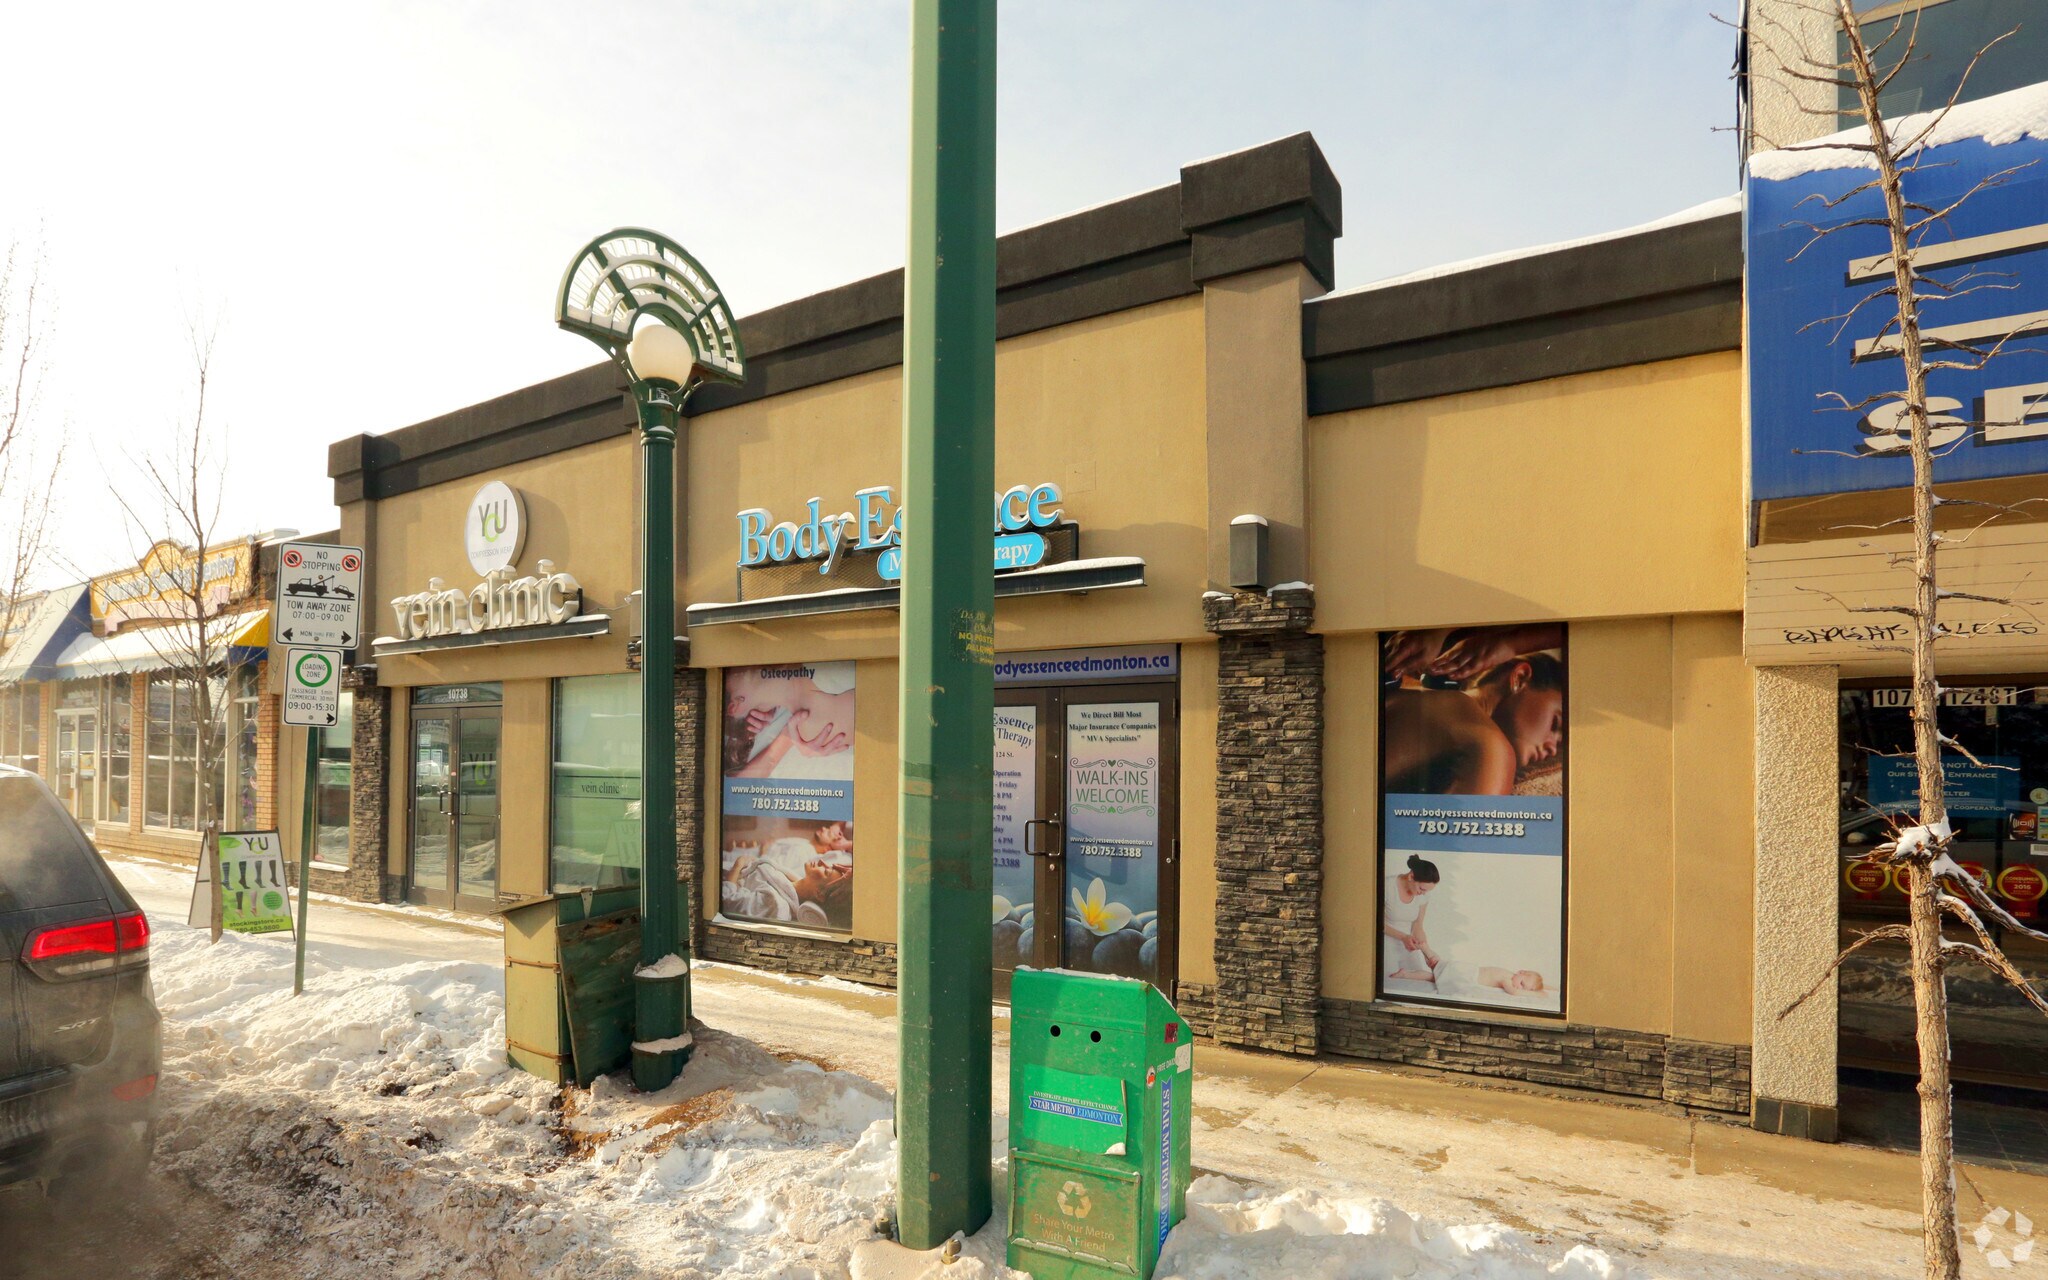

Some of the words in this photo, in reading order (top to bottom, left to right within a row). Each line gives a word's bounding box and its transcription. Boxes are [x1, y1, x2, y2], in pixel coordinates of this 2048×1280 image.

[736, 498, 850, 575] Body
[317, 551, 328, 559] NO
[994, 543, 1033, 567] rapy
[302, 561, 340, 571] STOPPING
[286, 600, 303, 609] TOW
[306, 602, 327, 610] AWAY
[329, 603, 351, 612] ZONE
[391, 580, 465, 639] vein
[467, 562, 578, 633] clinic
[760, 666, 815, 680] Osteopathy
[995, 655, 1169, 678] odyessenceedmonton.ca
[448, 688, 468, 699] 10738
[1121, 723, 1157, 731] Companies
[997, 728, 1032, 749] Therapy
[1077, 771, 1148, 785] WALK-INS
[581, 782, 597, 793] vein
[599, 783, 620, 794] clinic
[731, 785, 844, 798] www.bodyessenceedmonton.ca
[1076, 788, 1149, 803] WELCOME
[752, 797, 819, 812] 780.752.3388
[1394, 808, 1552, 820] www.bodyessenceedmonton.ca
[1419, 820, 1525, 837] 780.752.3388
[1080, 845, 1142, 857] 780.752.3388
[229, 919, 284, 927] stockingstore.ca
[54, 1017, 102, 1033] SRT
[1032, 1099, 1050, 1110] STAR
[1050, 1102, 1075, 1115] METRO
[1077, 1108, 1118, 1124] EDMONTON
[1162, 1089, 1170, 1128] STAR
[1161, 1132, 1170, 1189] METRO
[1034, 1213, 1060, 1228] Share
[1061, 1220, 1083, 1233] Your
[1085, 1225, 1115, 1240] Metro
[1042, 1229, 1062, 1241] With
[1075, 1237, 1106, 1252] Friend
